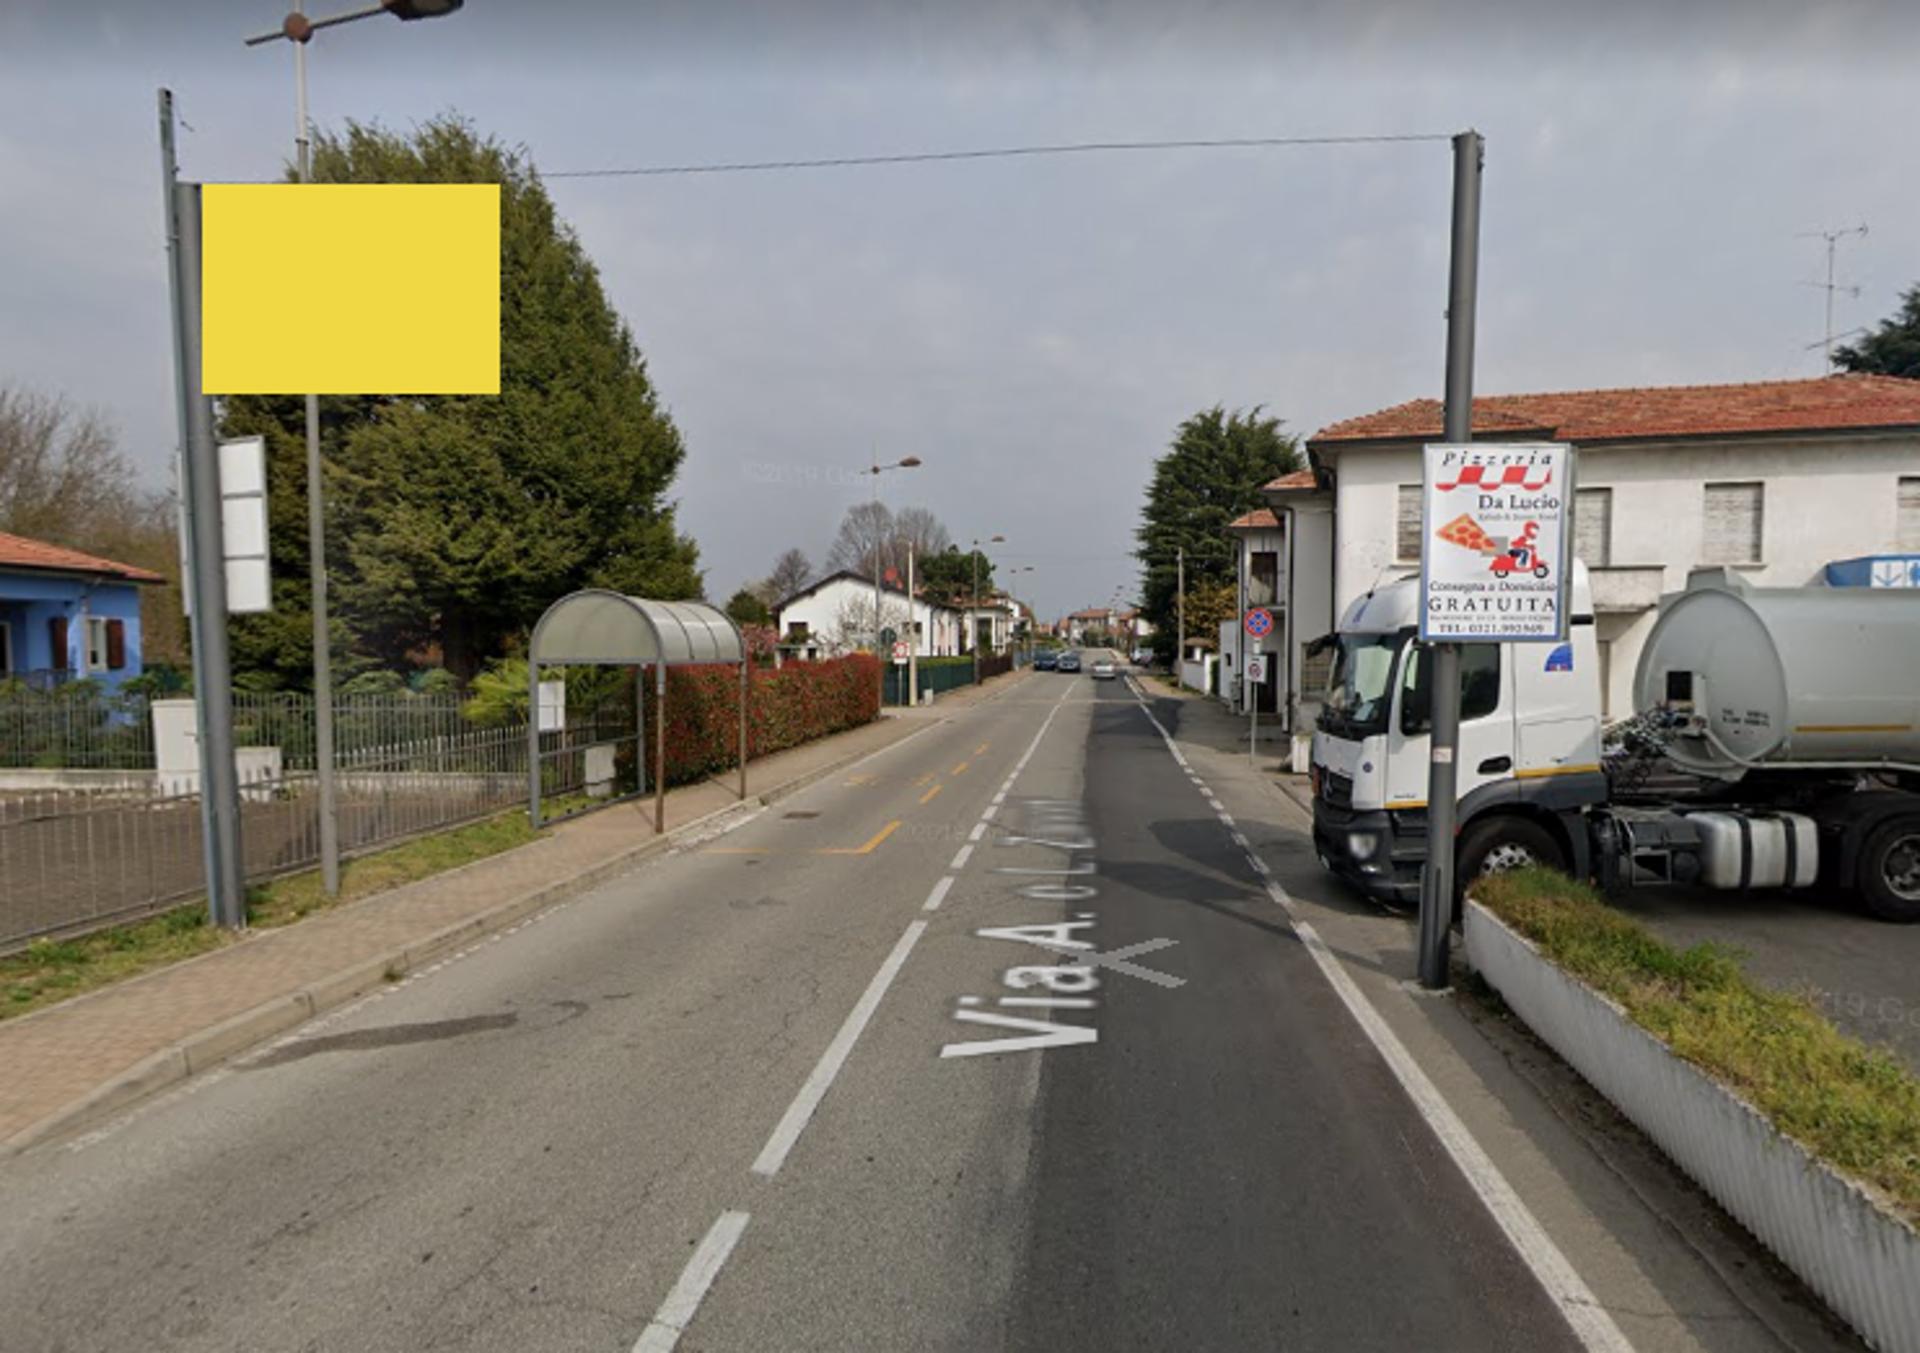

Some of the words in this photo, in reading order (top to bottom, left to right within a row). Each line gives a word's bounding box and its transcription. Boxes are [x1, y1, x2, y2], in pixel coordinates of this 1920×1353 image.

[1442, 450, 1553, 466] Pizzeria
[1478, 494, 1504, 509] Da
[1509, 493, 1560, 509] Lucio
[1429, 580, 1486, 594] Consegna
[1498, 579, 1557, 592] Domicilio
[1428, 597, 1556, 612] GRATUITA
